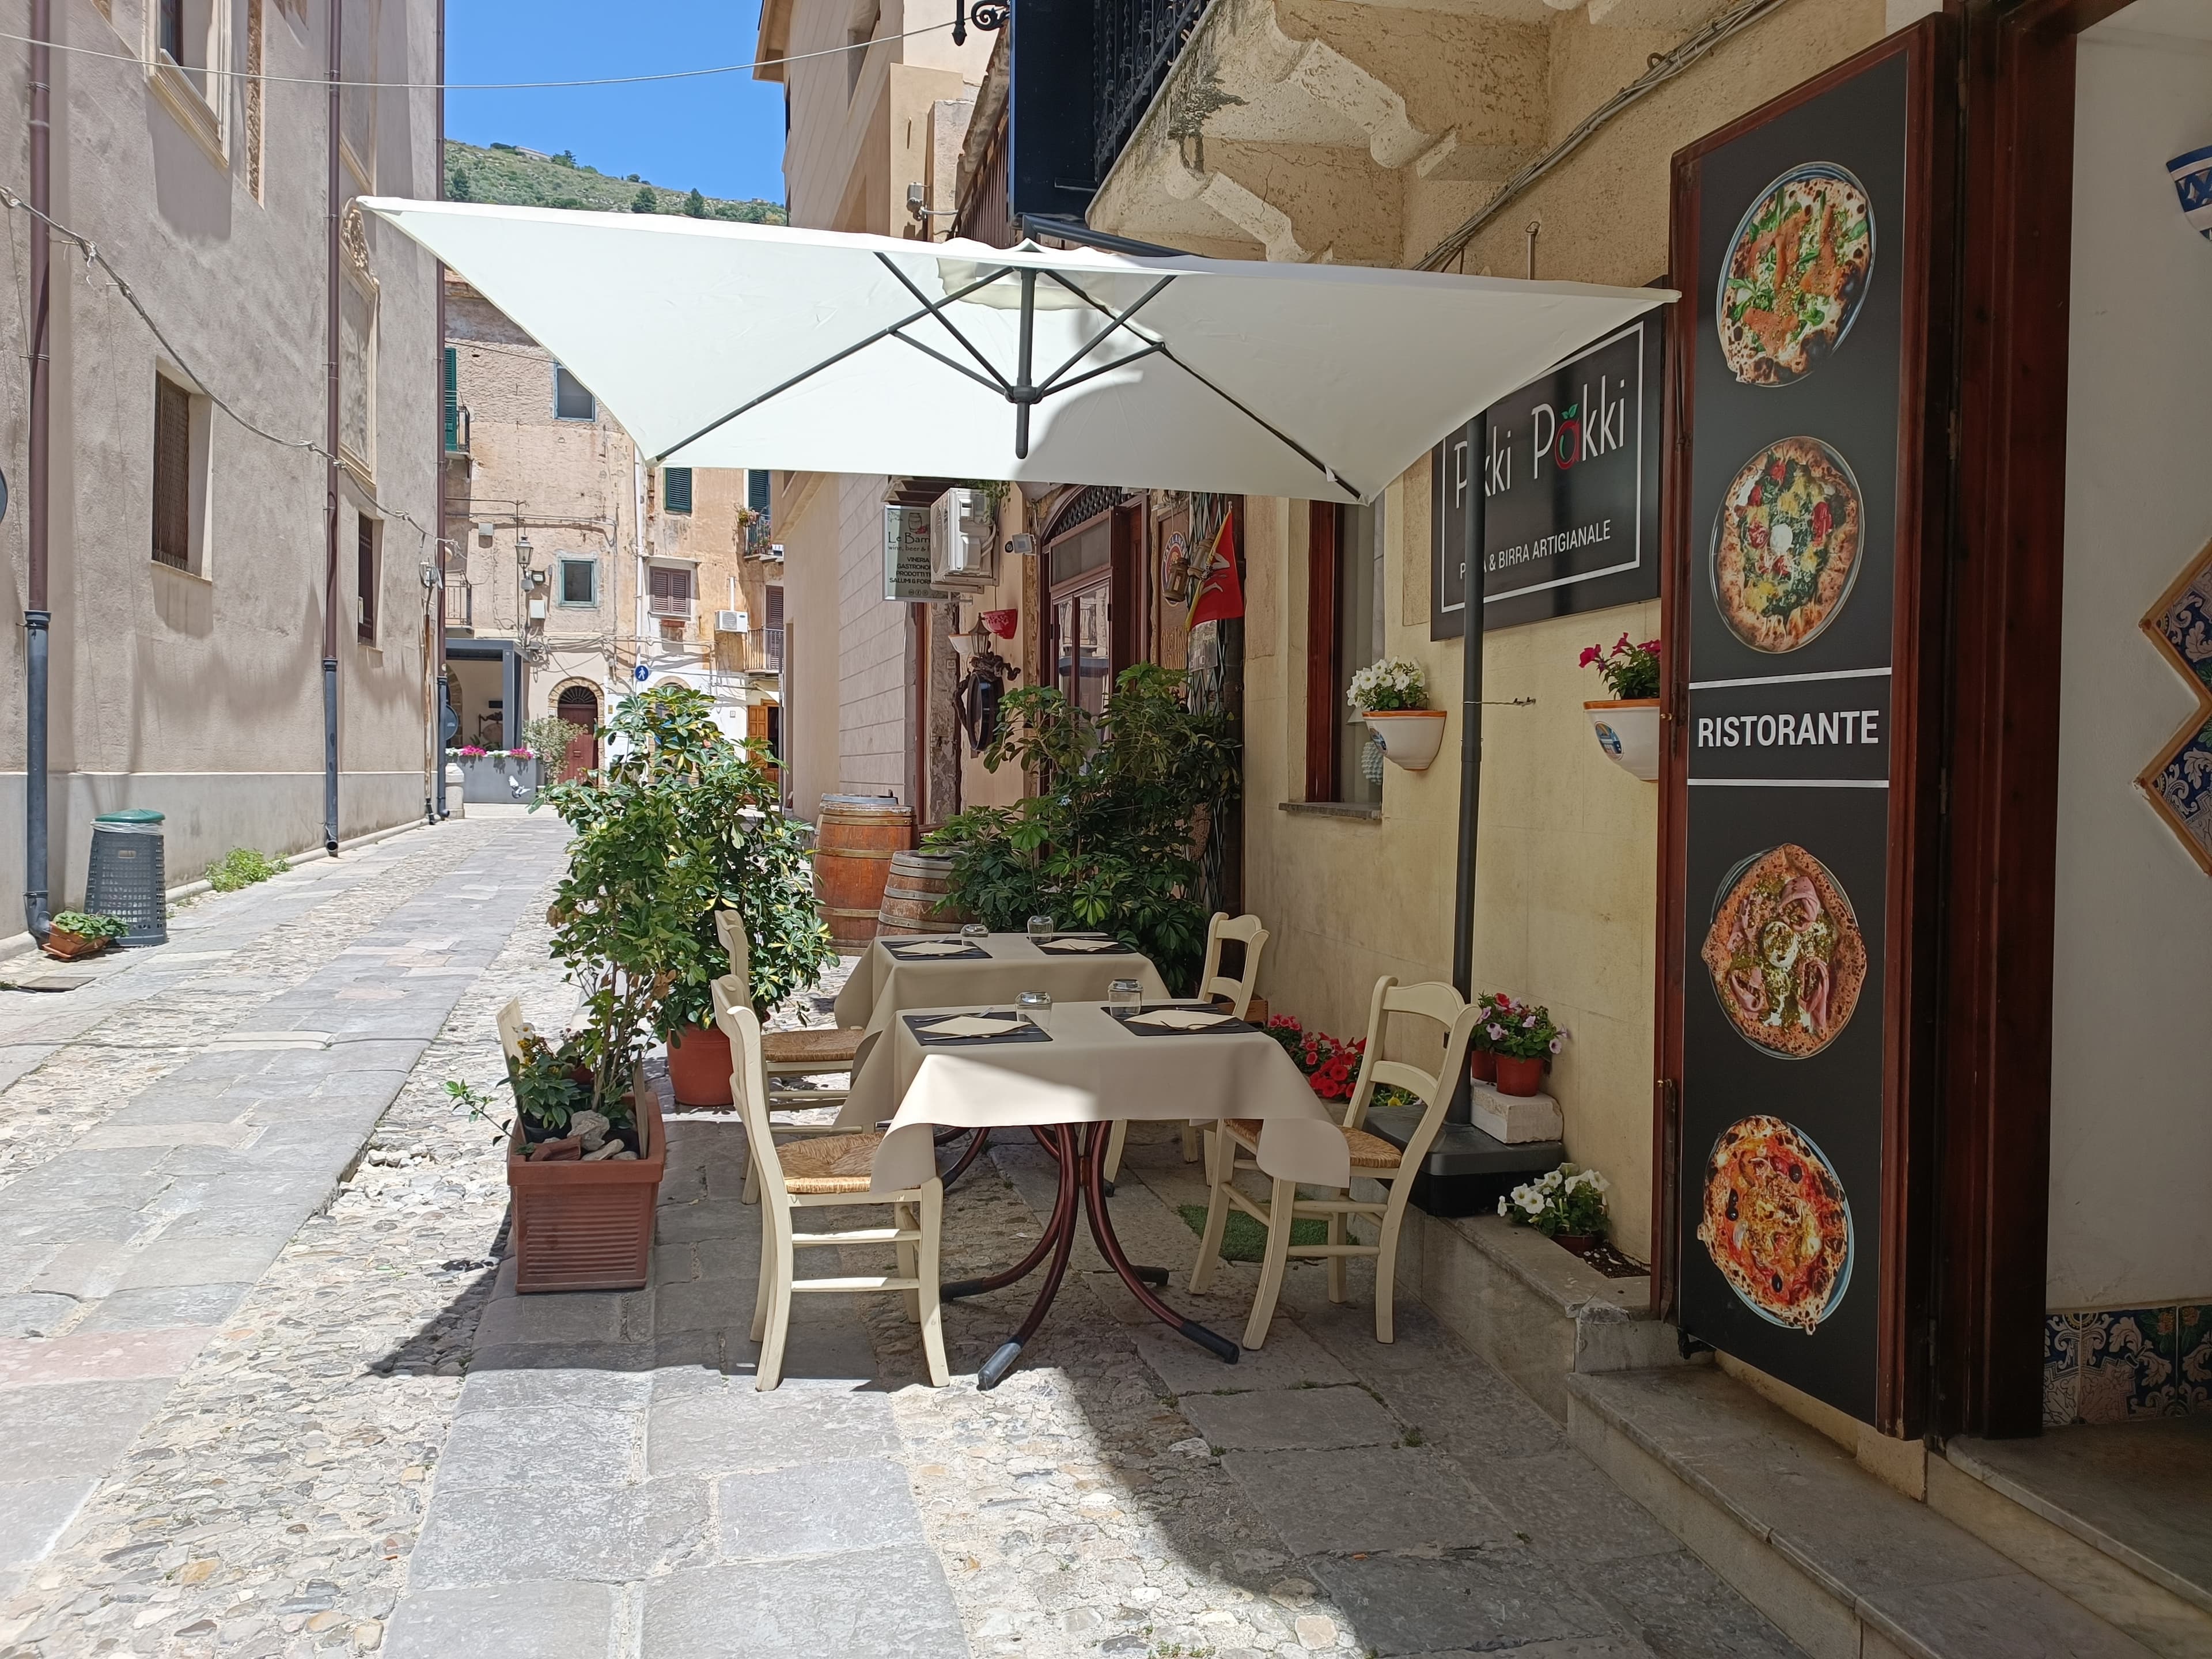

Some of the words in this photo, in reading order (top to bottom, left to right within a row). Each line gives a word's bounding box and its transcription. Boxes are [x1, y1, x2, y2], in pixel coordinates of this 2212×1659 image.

[1531, 374, 1624, 479] Pakki
[888, 532, 902, 543] Le
[1499, 543, 1530, 569] BIRRA
[1532, 519, 1611, 560] ARTIGIANALE
[1698, 710, 1880, 748] RISTORANTE
